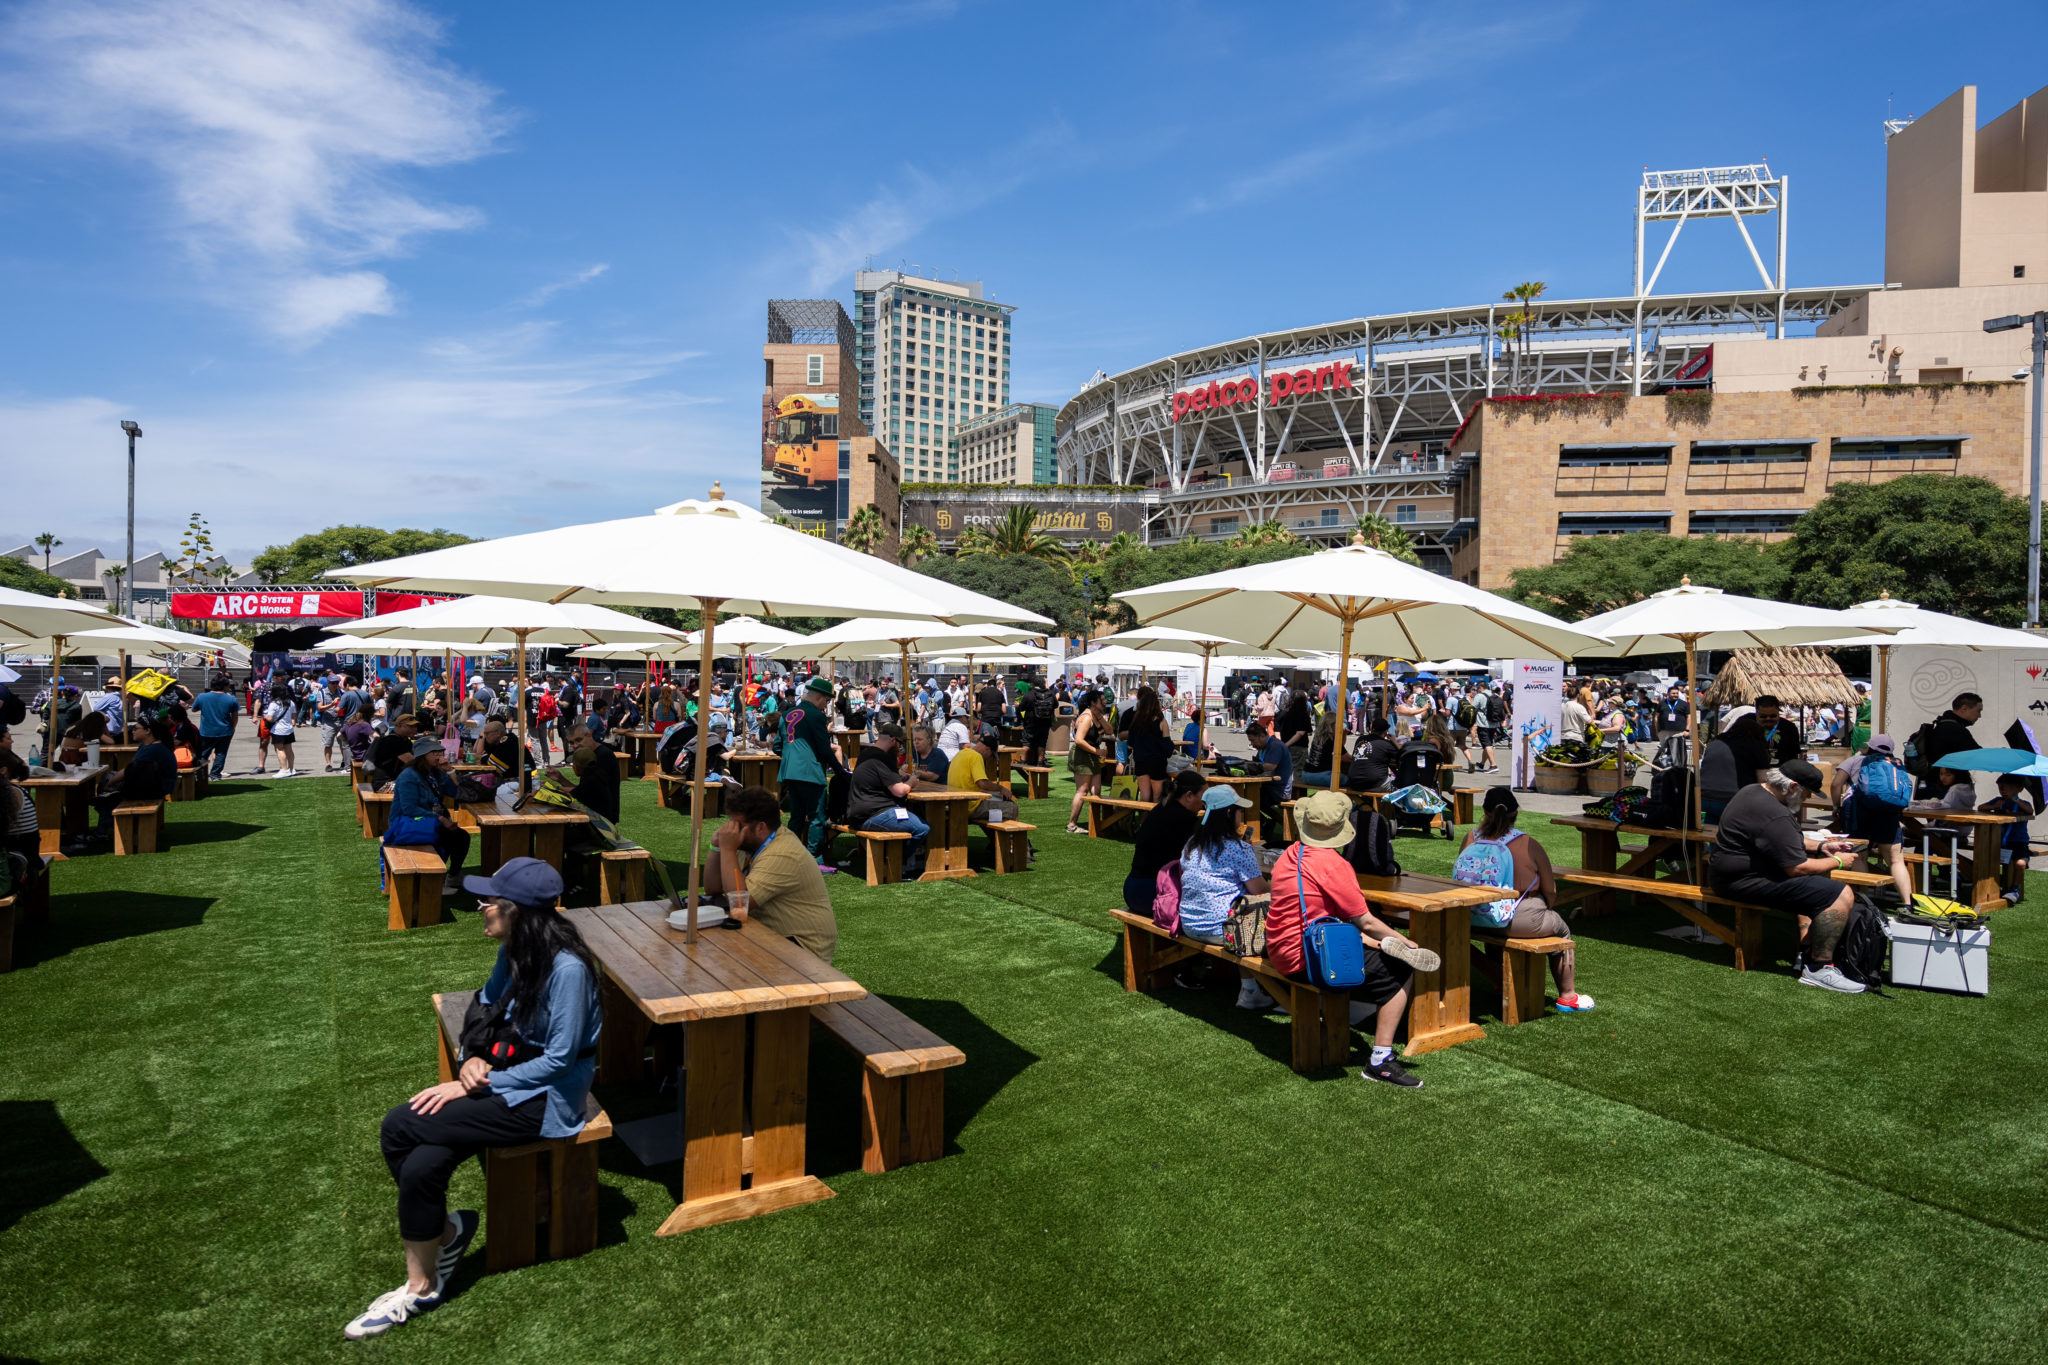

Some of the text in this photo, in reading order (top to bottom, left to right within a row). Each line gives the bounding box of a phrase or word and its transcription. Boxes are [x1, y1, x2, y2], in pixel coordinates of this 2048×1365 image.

[1173, 361, 1353, 423] petco park
[1030, 511, 1087, 529] aithful
[800, 522, 827, 538] bott
[211, 595, 294, 616] ARC SYSTEM
[260, 606, 291, 615] WORKS
